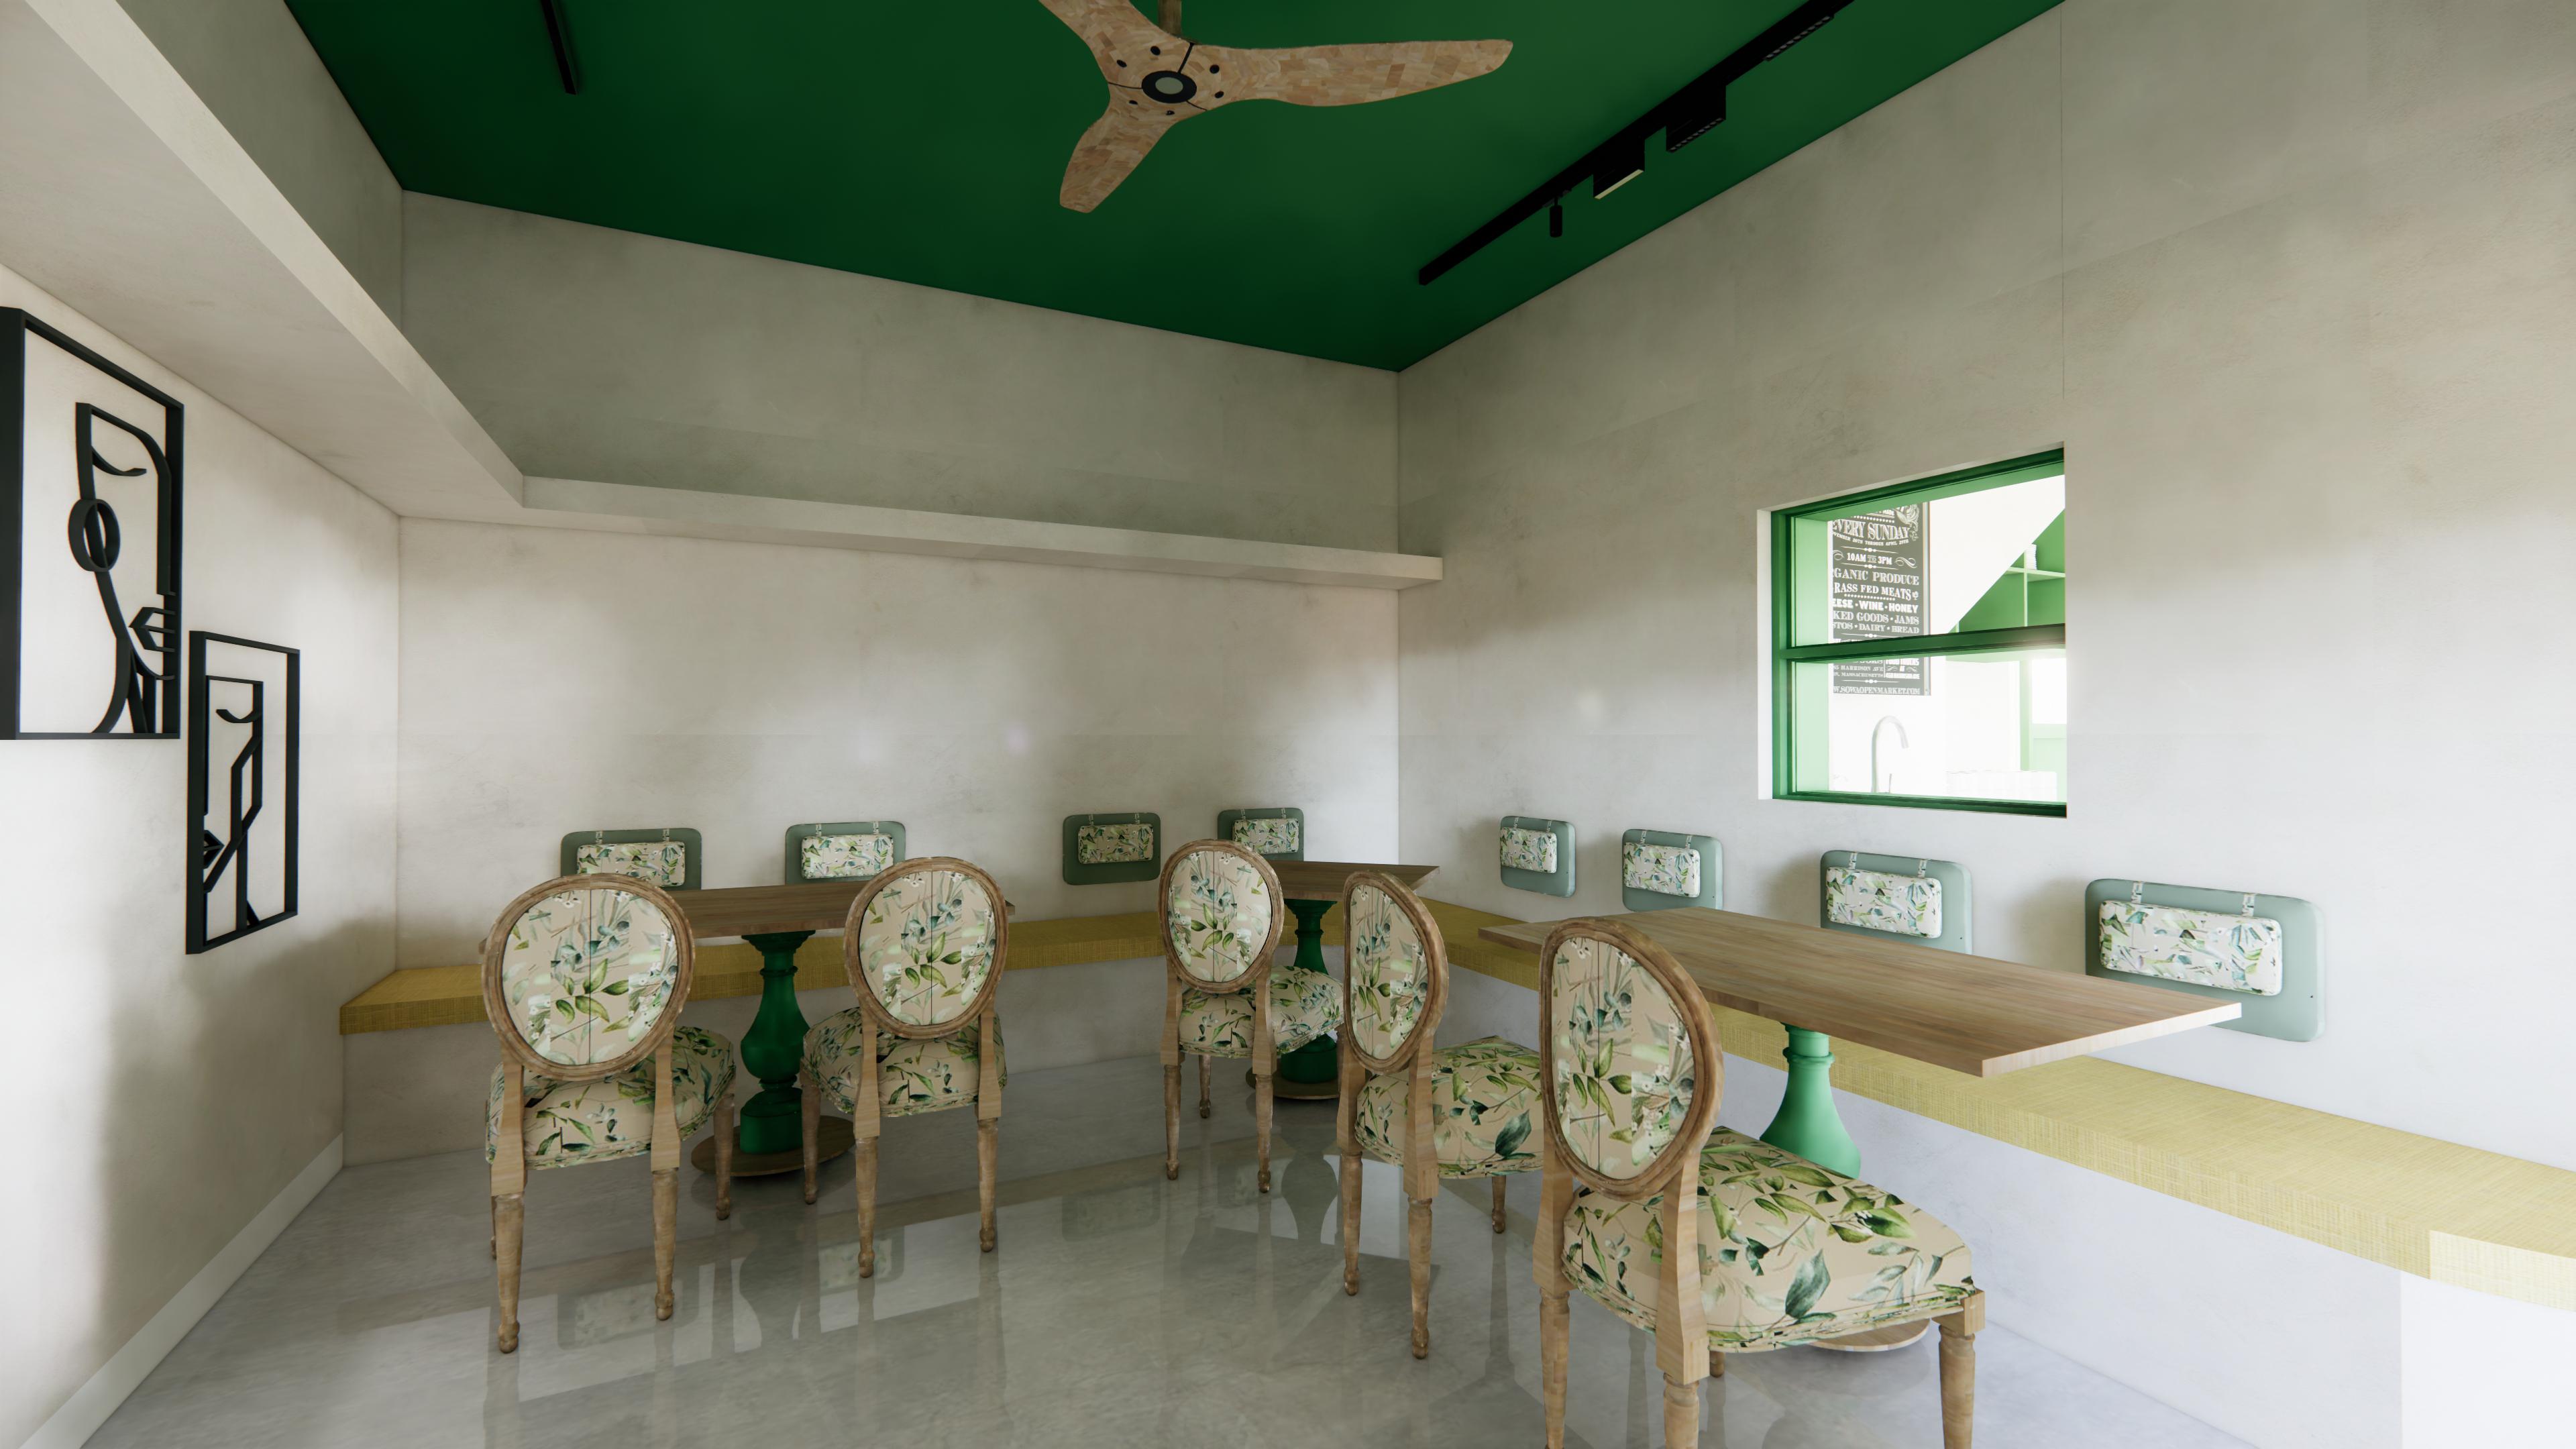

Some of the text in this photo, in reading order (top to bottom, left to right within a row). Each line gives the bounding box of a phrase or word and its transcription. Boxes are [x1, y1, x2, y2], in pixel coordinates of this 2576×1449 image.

[1833, 519, 1911, 540] EVERY SUNDAY
[1833, 531, 1851, 541] VEMBER
[1847, 553, 1866, 562] 10AM
[1878, 556, 1892, 565] 3PM
[1833, 568, 1919, 586] GANIC PRODUCE
[1860, 585, 1879, 594] FED
[1881, 586, 1911, 601] MEATS
[1858, 600, 1884, 610] WINE
[1888, 602, 1919, 613] HONEY
[1856, 612, 1889, 623] GOODS
[1894, 615, 1919, 625] JAMS
[1858, 623, 1886, 632] DAIRY
[1891, 625, 1919, 634] BREAD
